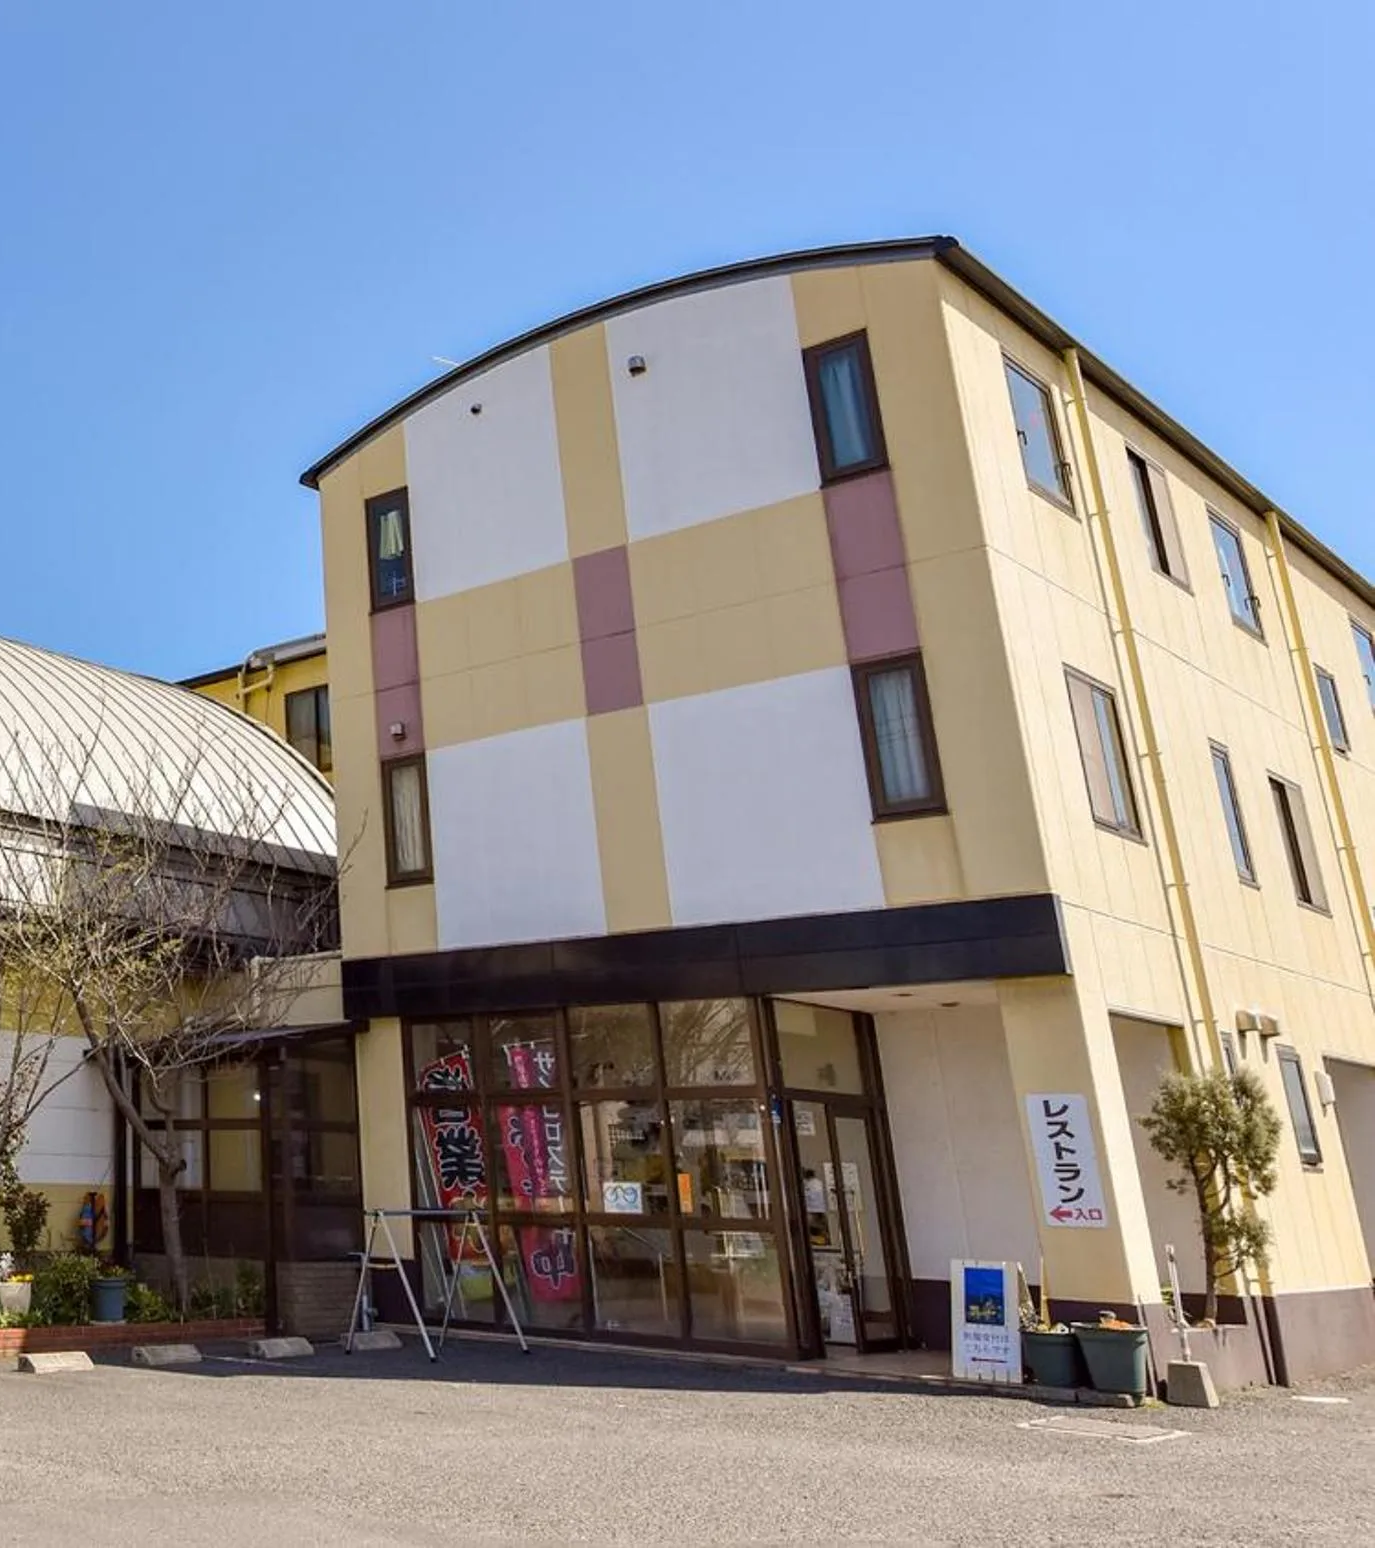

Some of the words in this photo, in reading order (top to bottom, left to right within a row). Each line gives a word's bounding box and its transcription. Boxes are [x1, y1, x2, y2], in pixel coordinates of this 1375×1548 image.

[1043, 1100, 1084, 1203] レストラン
[1075, 1208, 1102, 1220] 入口
